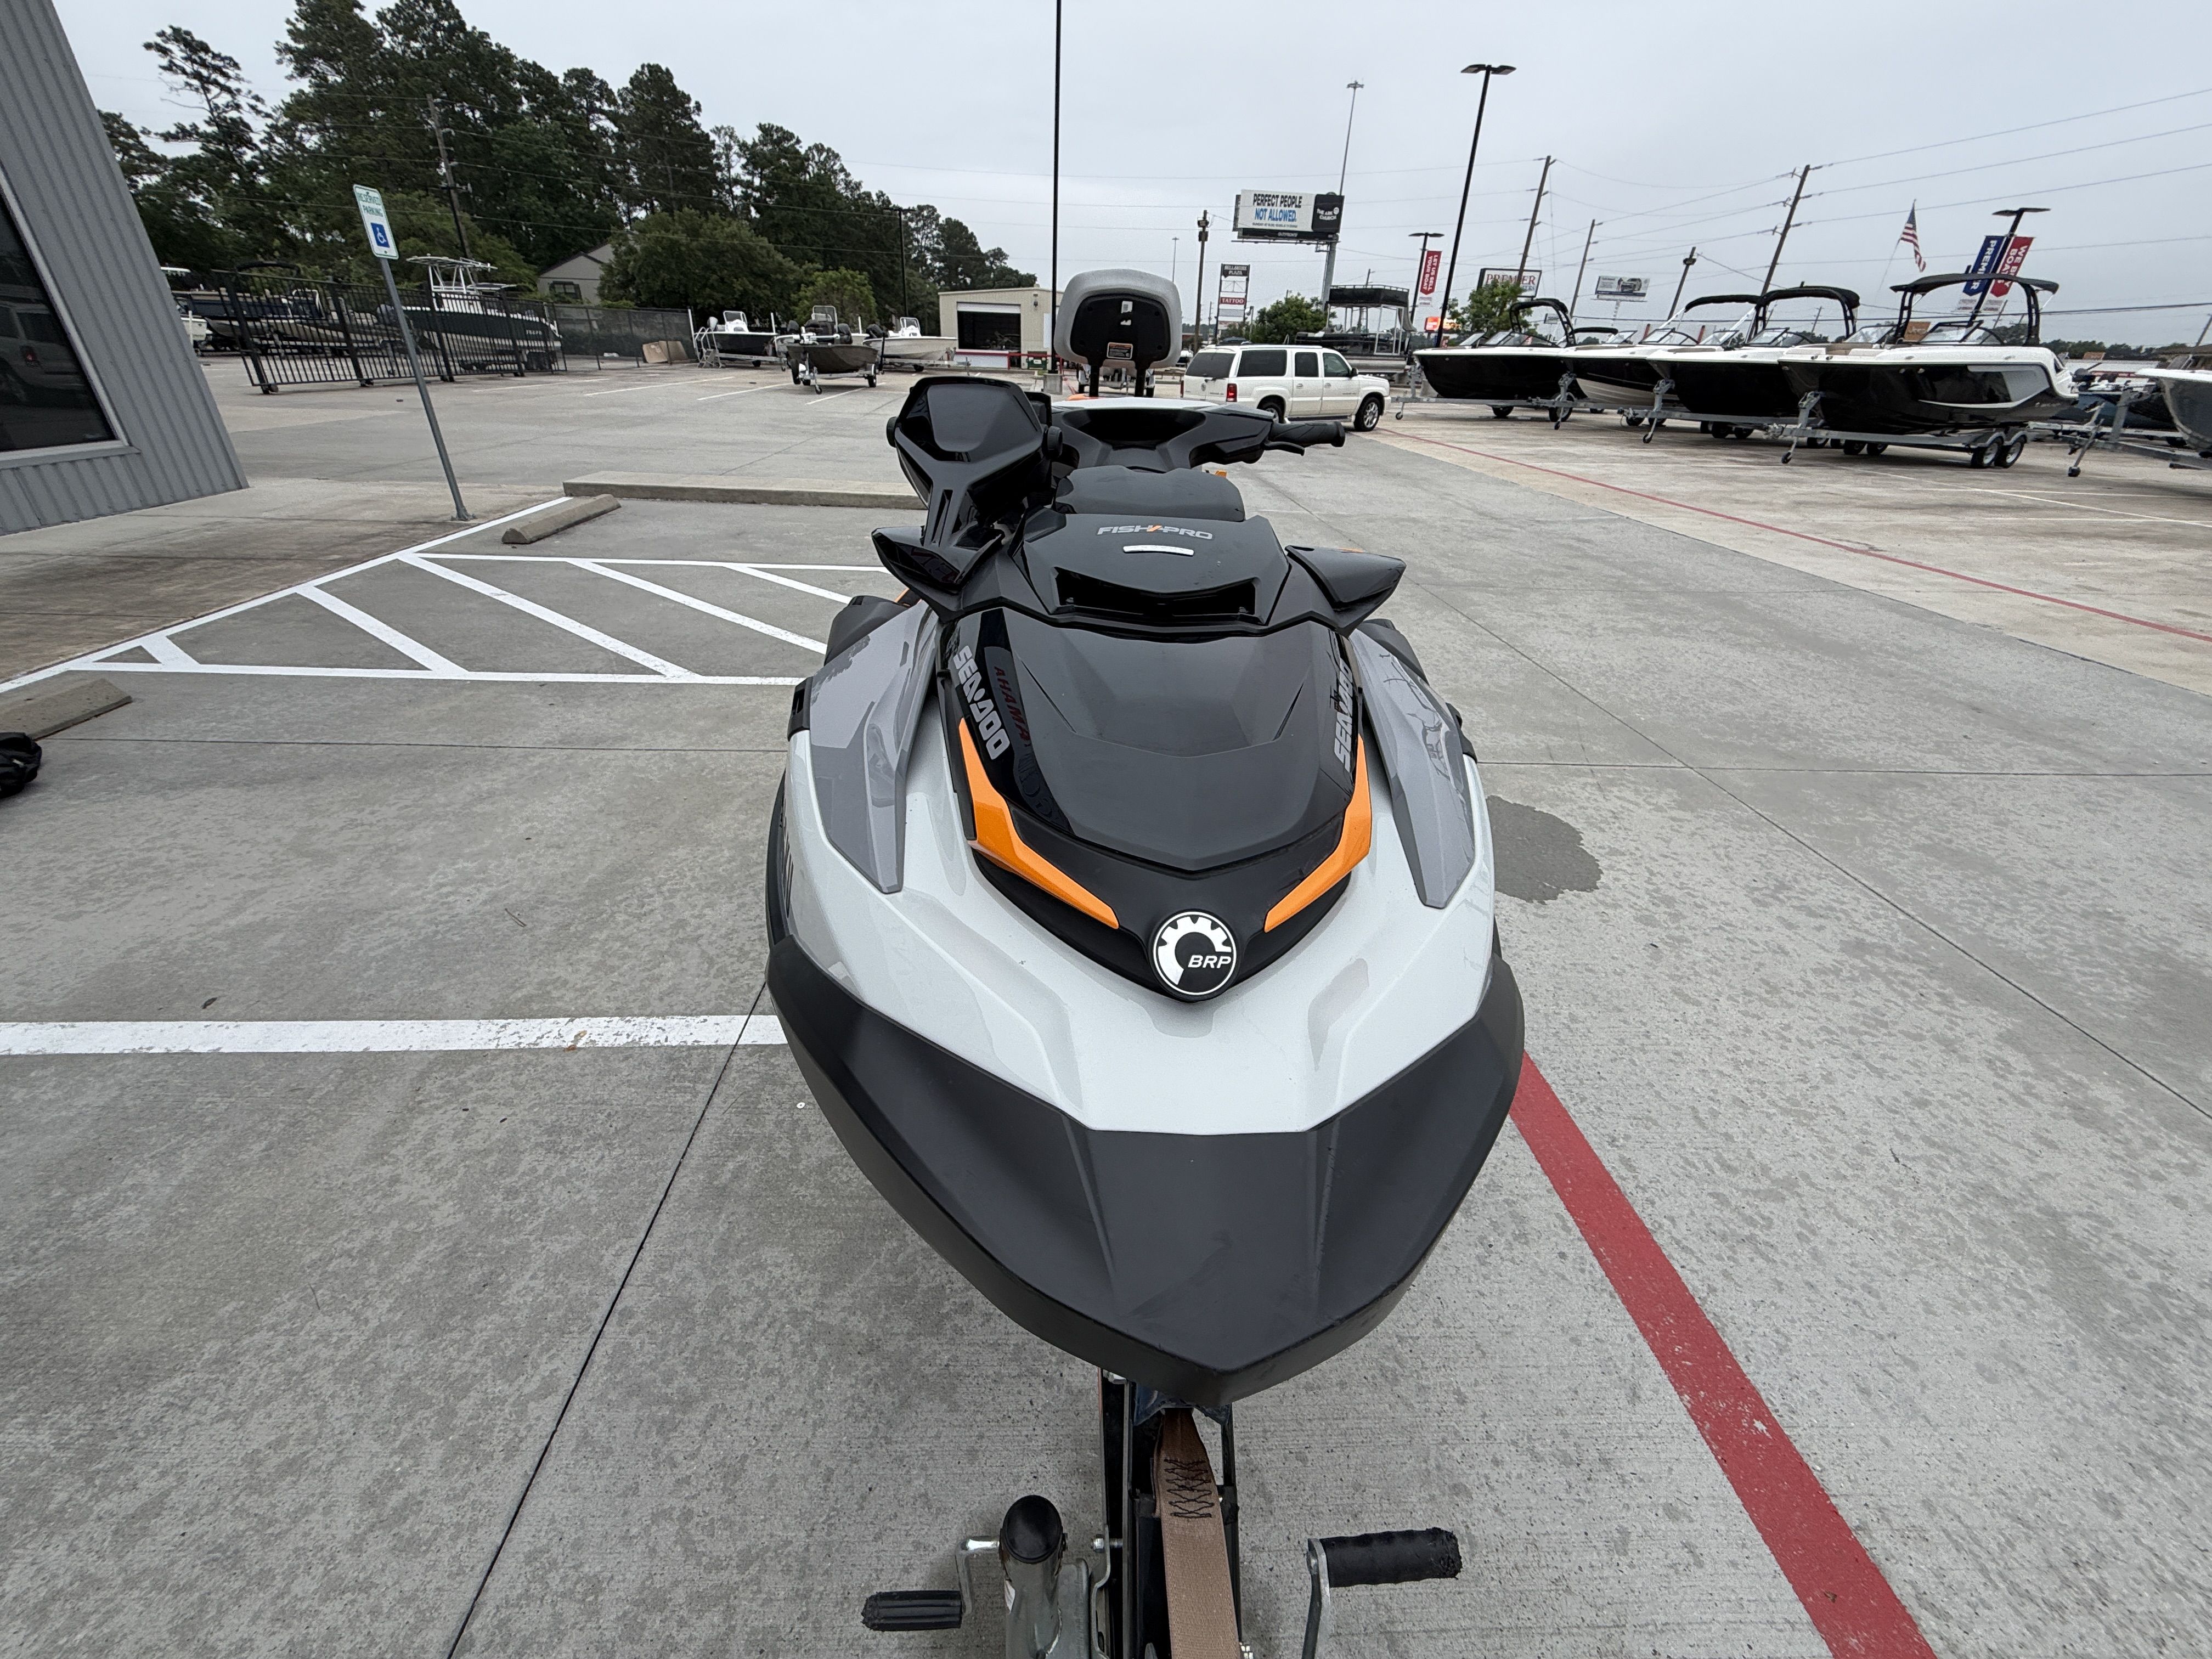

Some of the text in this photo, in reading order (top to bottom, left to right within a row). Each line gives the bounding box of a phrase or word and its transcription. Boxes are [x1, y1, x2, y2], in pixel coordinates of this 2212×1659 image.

[357, 193, 381, 205] RESERVED
[1253, 193, 1302, 208] PERFECT PEOPLE
[362, 205, 383, 217] PARKING
[1254, 208, 1268, 220] NOT
[2014, 245, 2028, 264] WE
[1970, 240, 1997, 290] PREMIR
[1486, 274, 1536, 285] PREMER
[1188, 955, 1232, 969] BRP
